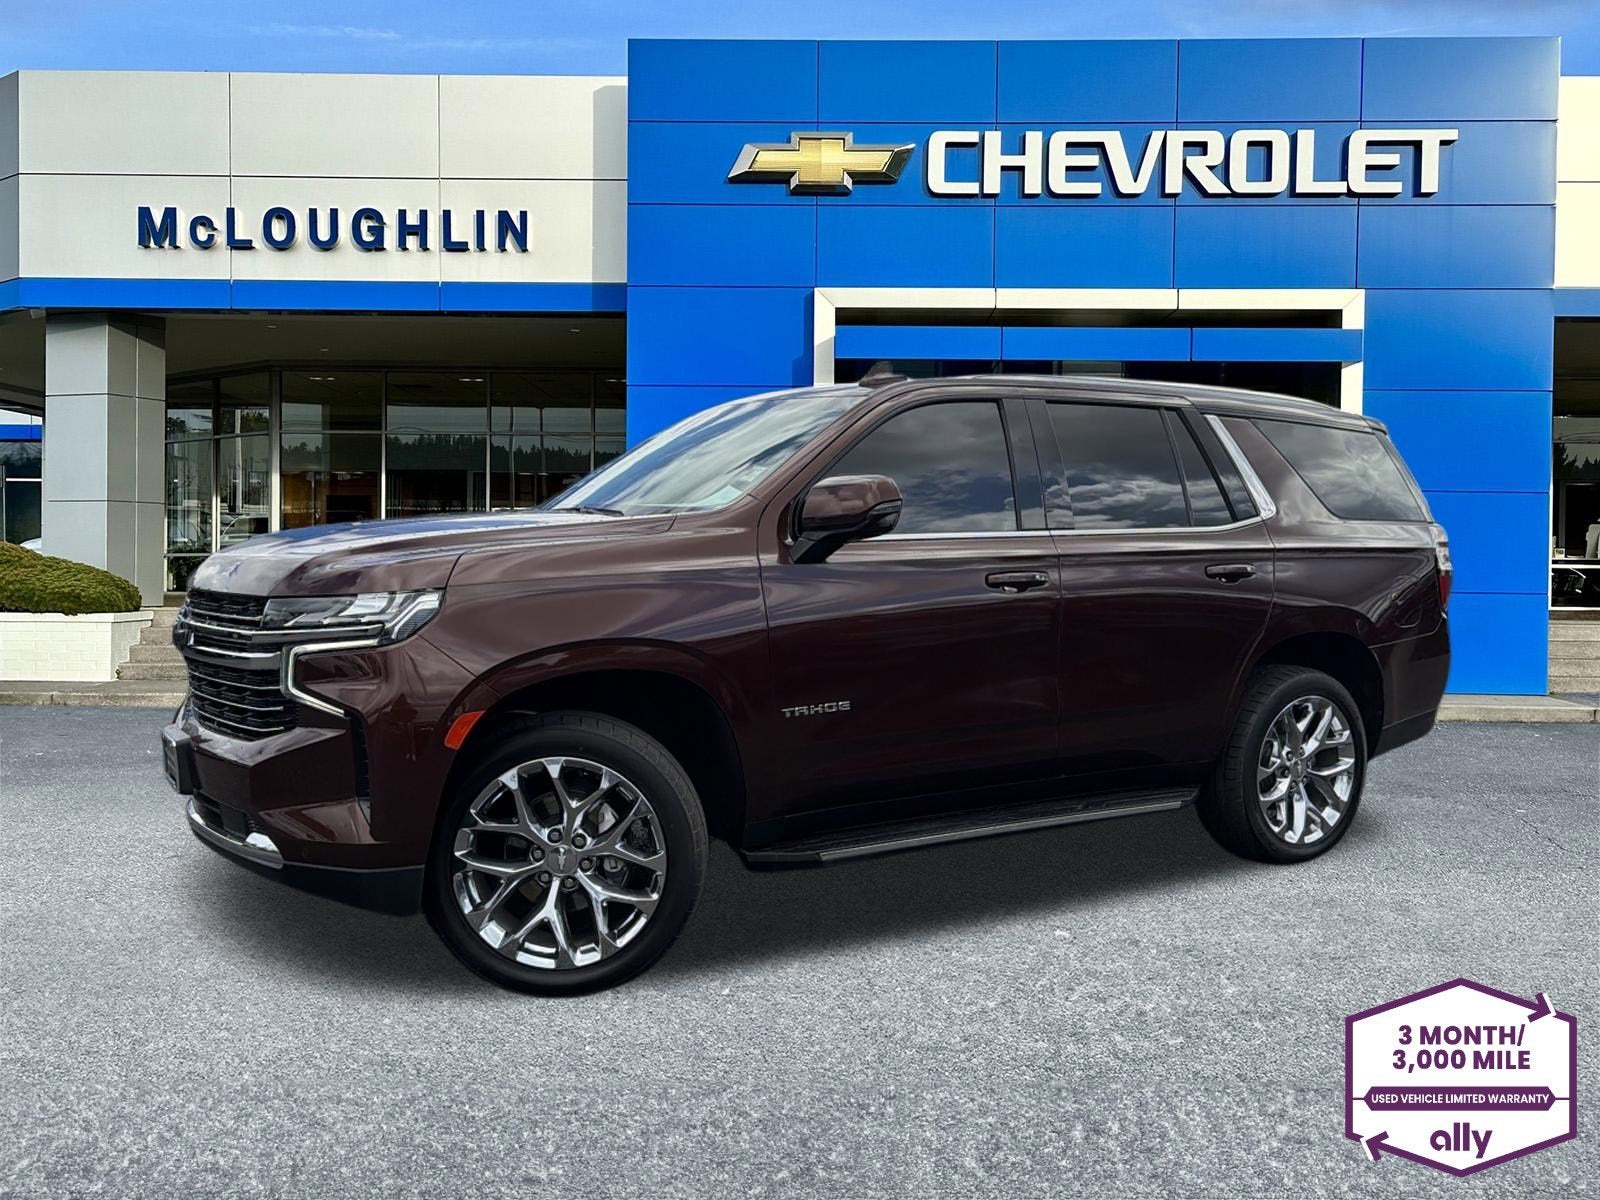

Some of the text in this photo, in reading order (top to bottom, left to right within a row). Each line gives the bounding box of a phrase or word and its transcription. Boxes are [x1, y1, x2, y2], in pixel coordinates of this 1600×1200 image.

[927, 129, 1458, 195] CHEVROLET
[137, 206, 529, 252] McLOUGHLIN
[781, 701, 851, 718] TAHOE
